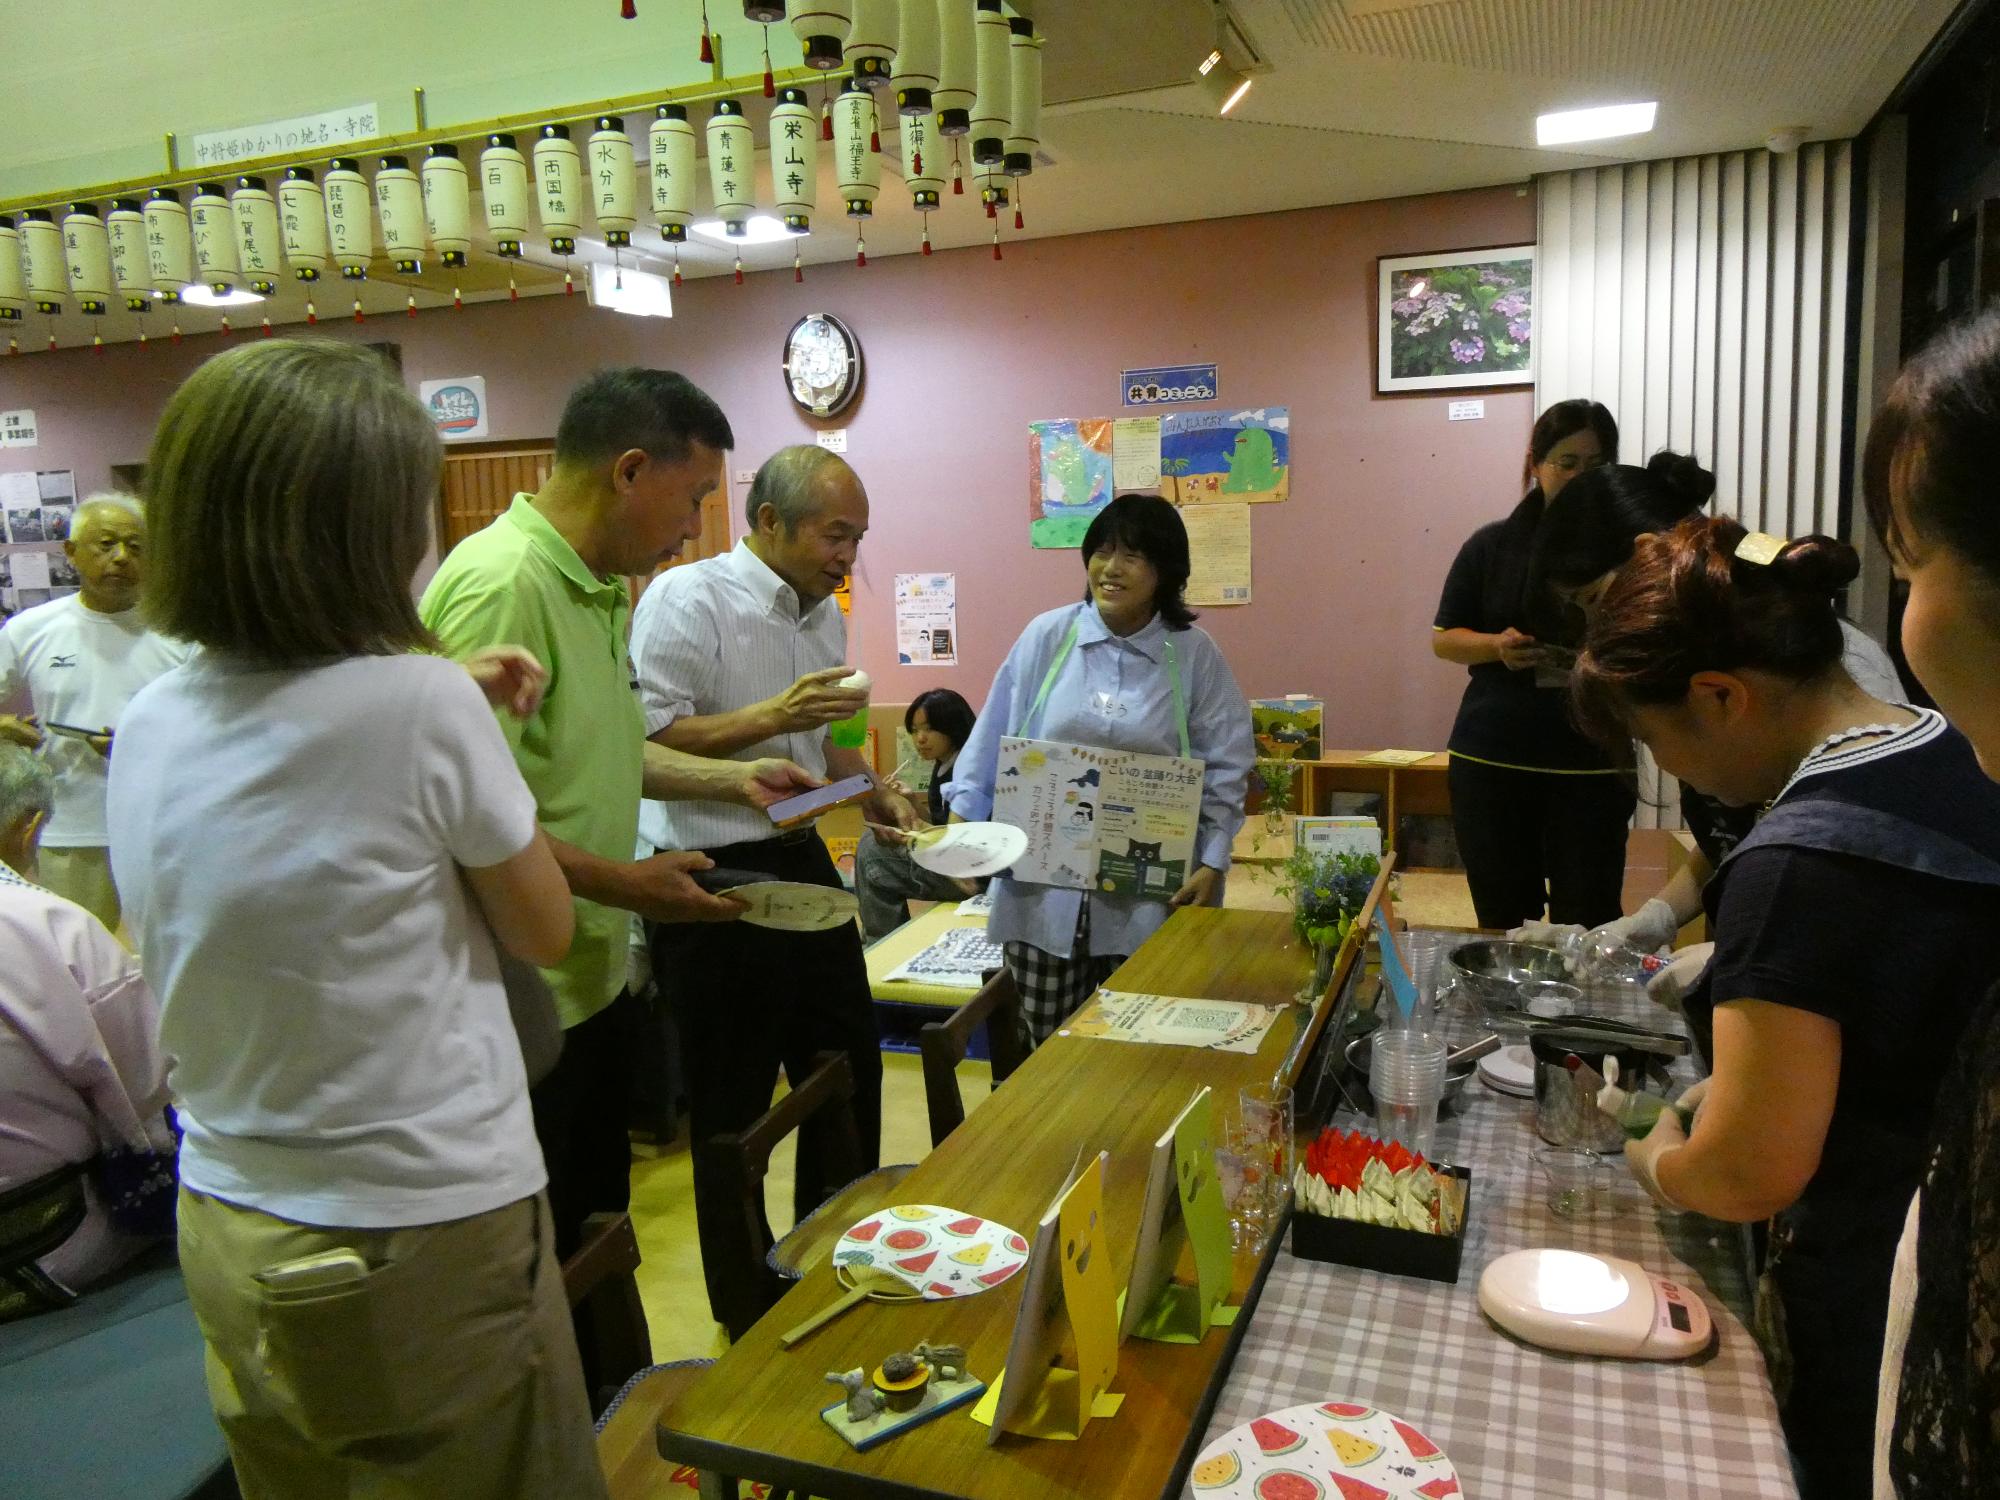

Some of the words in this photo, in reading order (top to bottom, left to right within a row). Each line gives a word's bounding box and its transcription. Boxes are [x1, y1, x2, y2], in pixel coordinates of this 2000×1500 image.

[544, 160, 566, 213] 両国橋
[655, 136, 671, 205] 当麻寺
[720, 130, 736, 198] 青蓮寺
[784, 120, 805, 196] 栄山寺
[489, 167, 505, 216] 百田
[1108, 765, 1140, 778] こいの
[1143, 768, 1198, 785] 盆踊り大会
